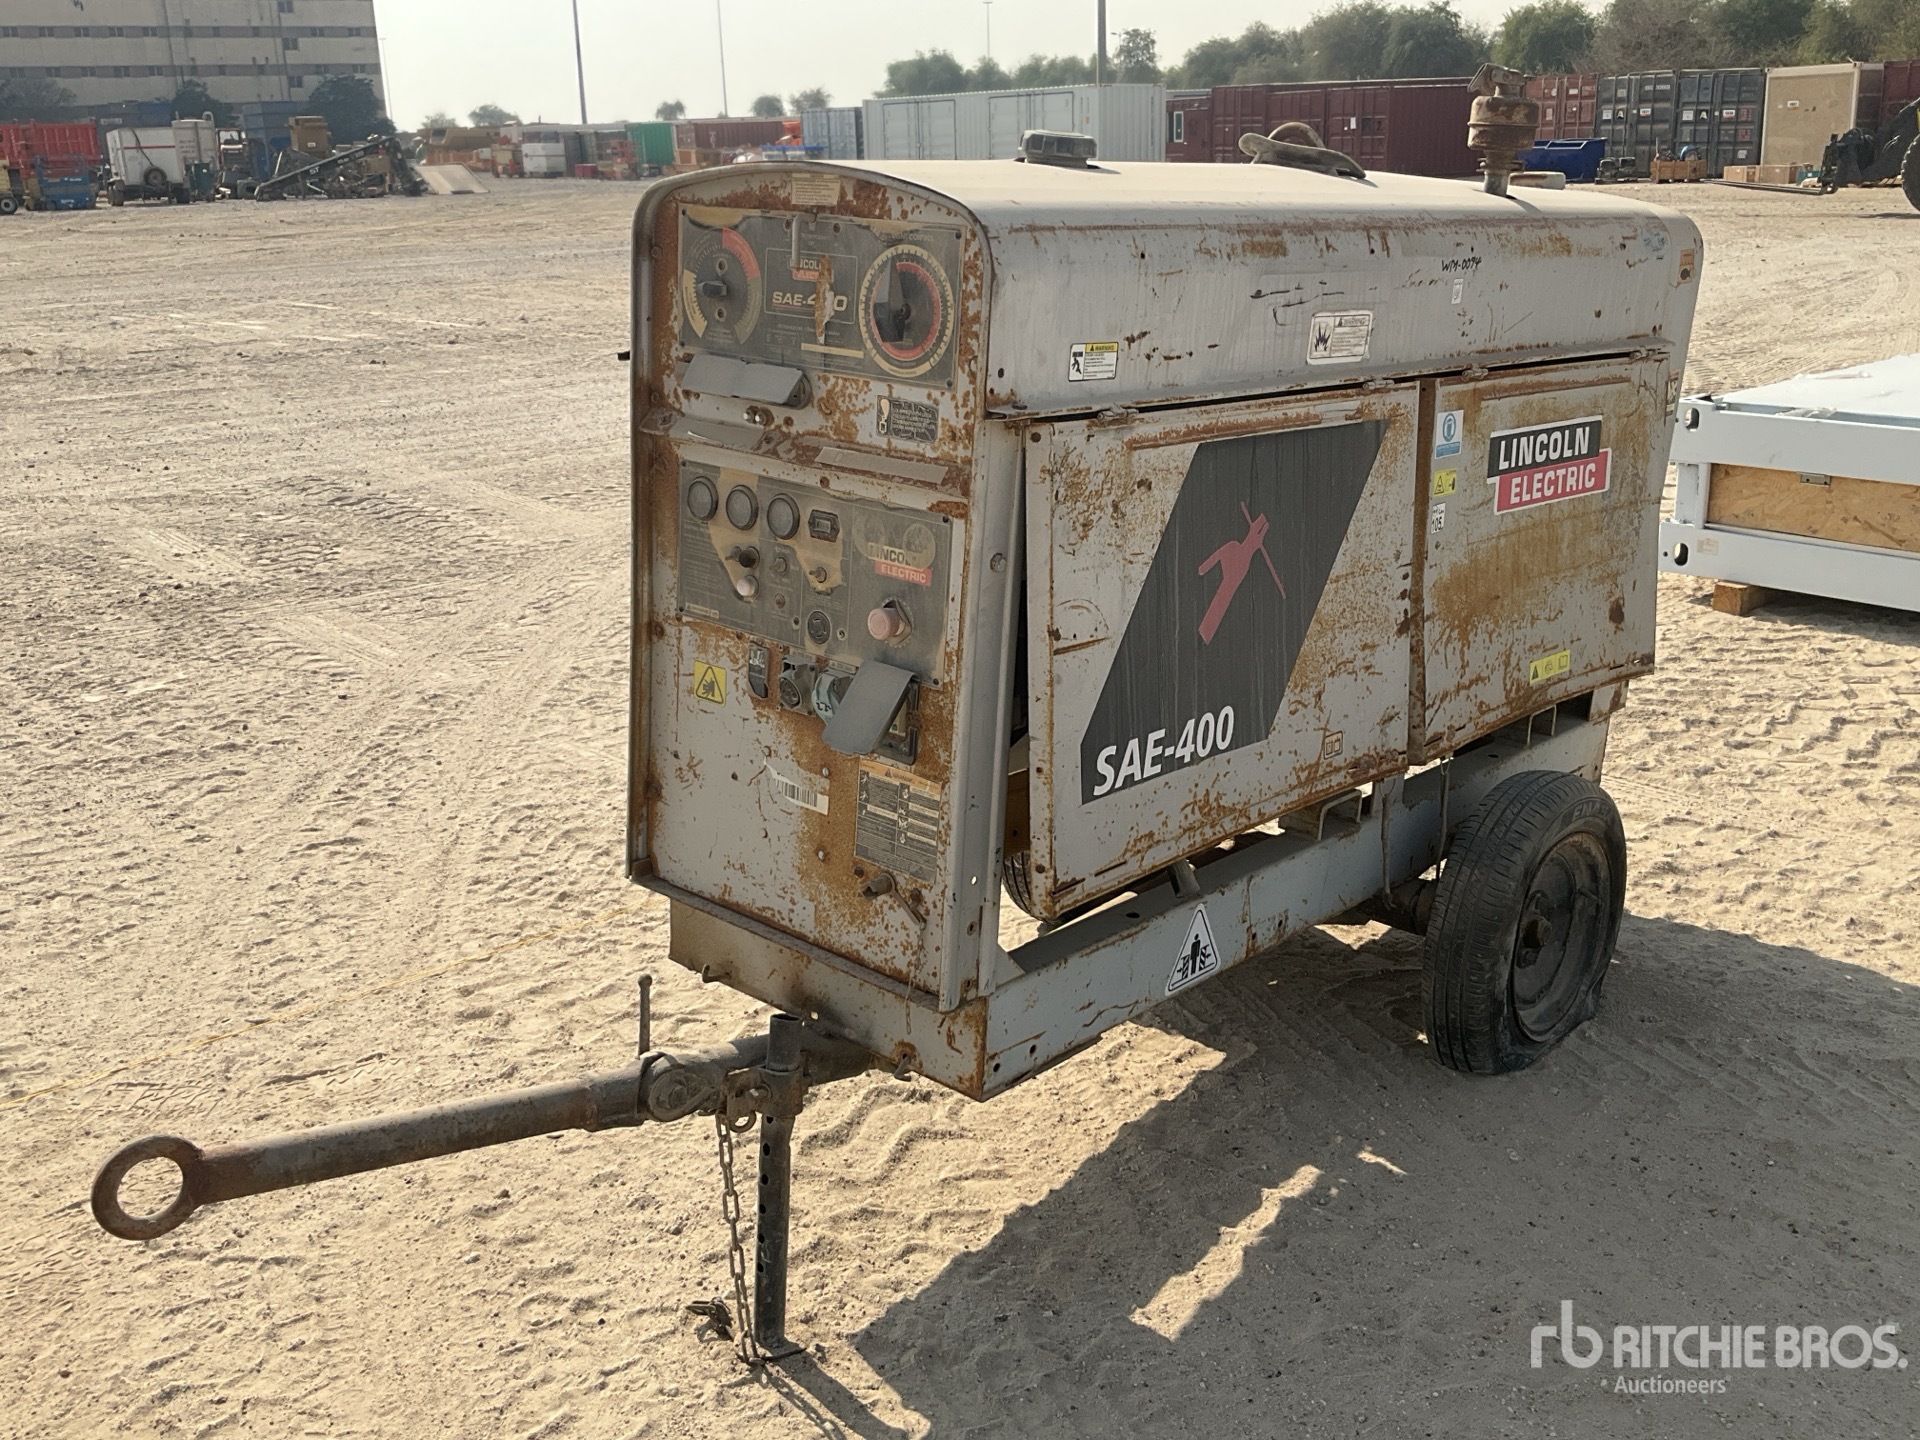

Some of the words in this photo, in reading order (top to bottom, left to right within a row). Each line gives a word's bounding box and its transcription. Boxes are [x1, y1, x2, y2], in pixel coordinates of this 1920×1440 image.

[1498, 426, 1591, 471] LINCOLN
[1509, 462, 1597, 505] ELECTRIC
[881, 563, 927, 583] ELECTRIC
[1092, 705, 1235, 796] SAE-400
